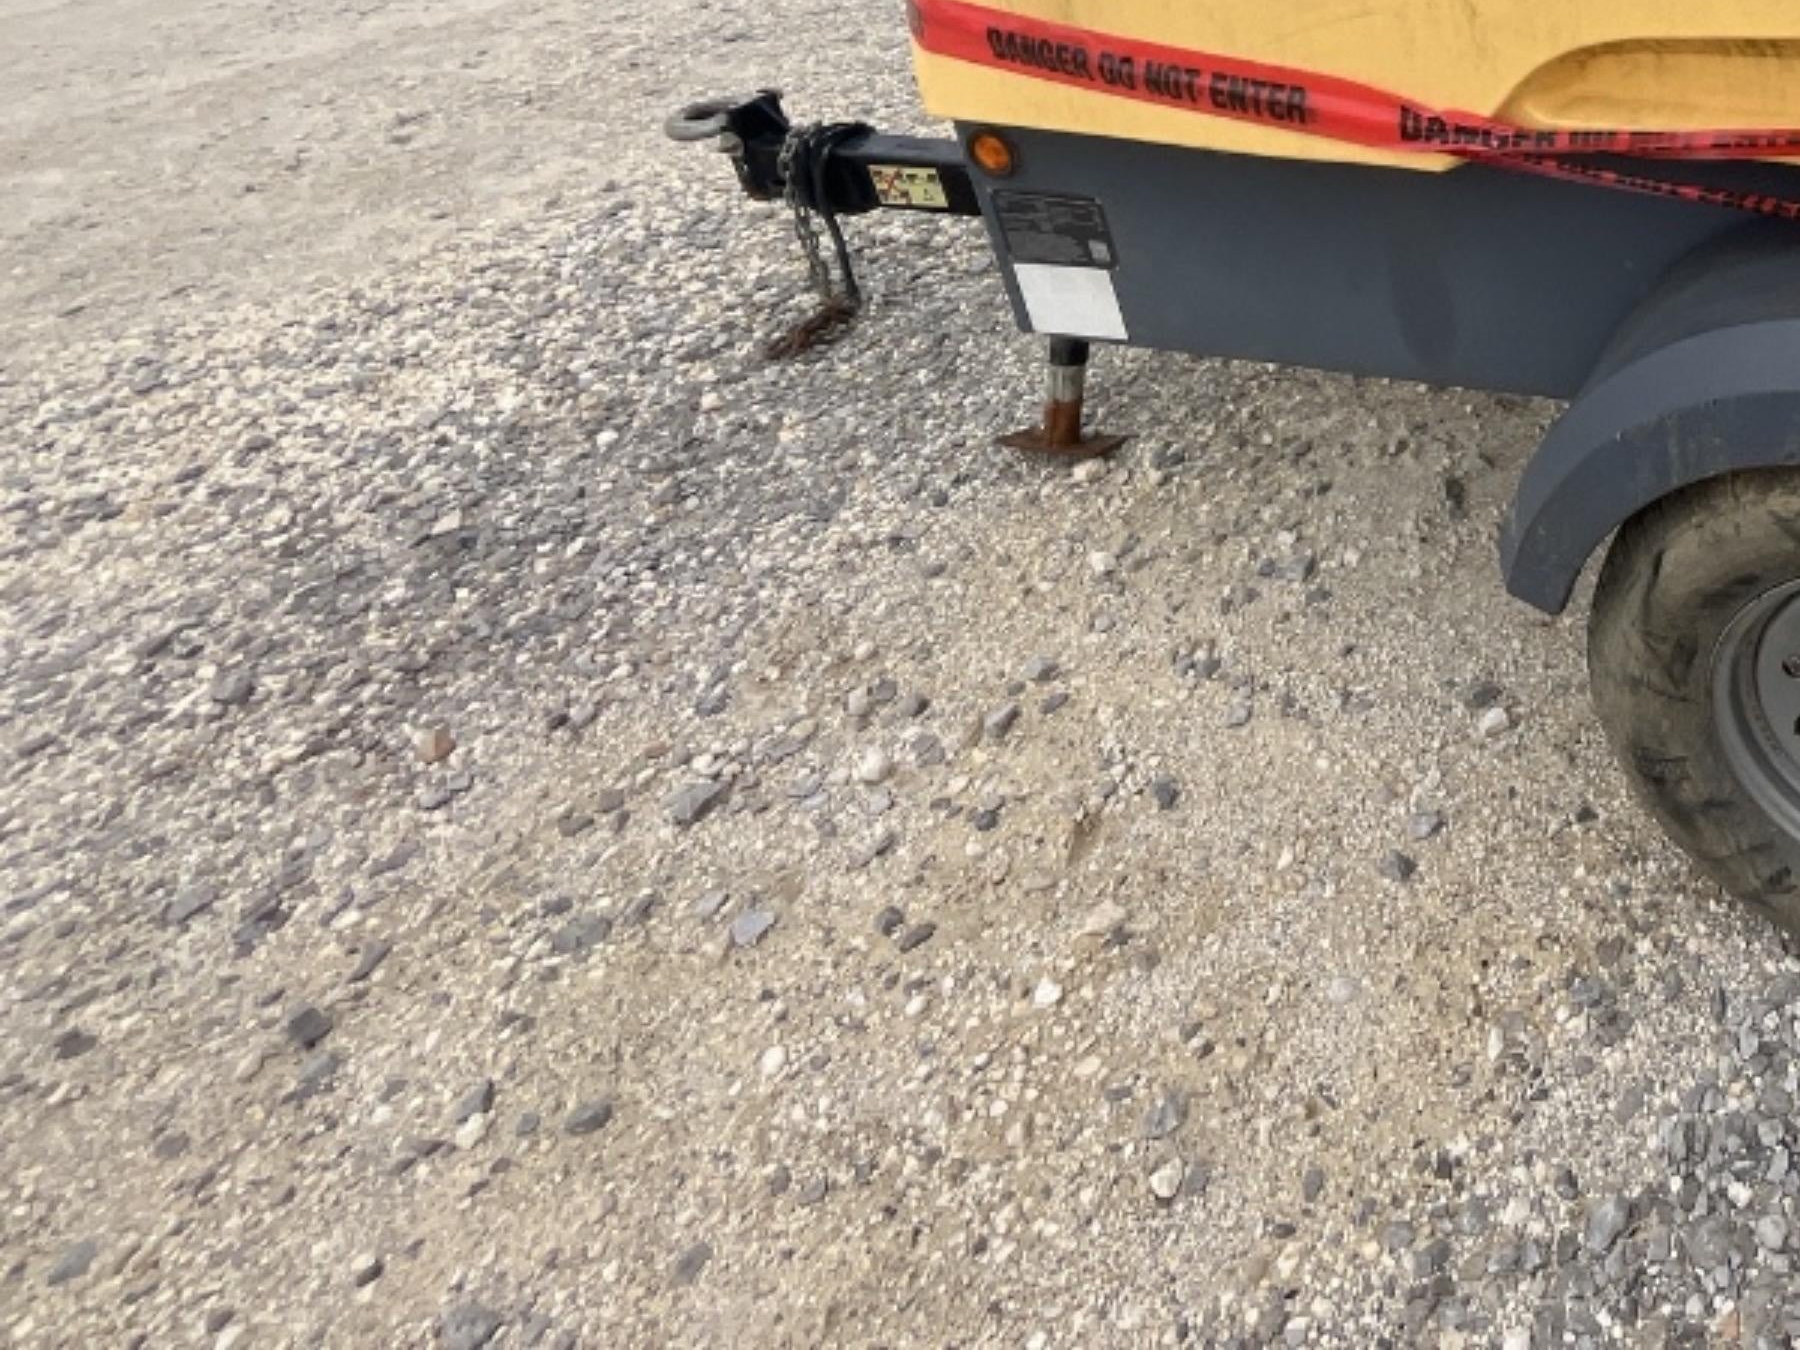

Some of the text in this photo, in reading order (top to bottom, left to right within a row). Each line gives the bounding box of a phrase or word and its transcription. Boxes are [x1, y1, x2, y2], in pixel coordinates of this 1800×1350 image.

[986, 26, 1095, 82] DANGER
[1143, 59, 1202, 103] NOT
[1208, 71, 1308, 124] ENTER
